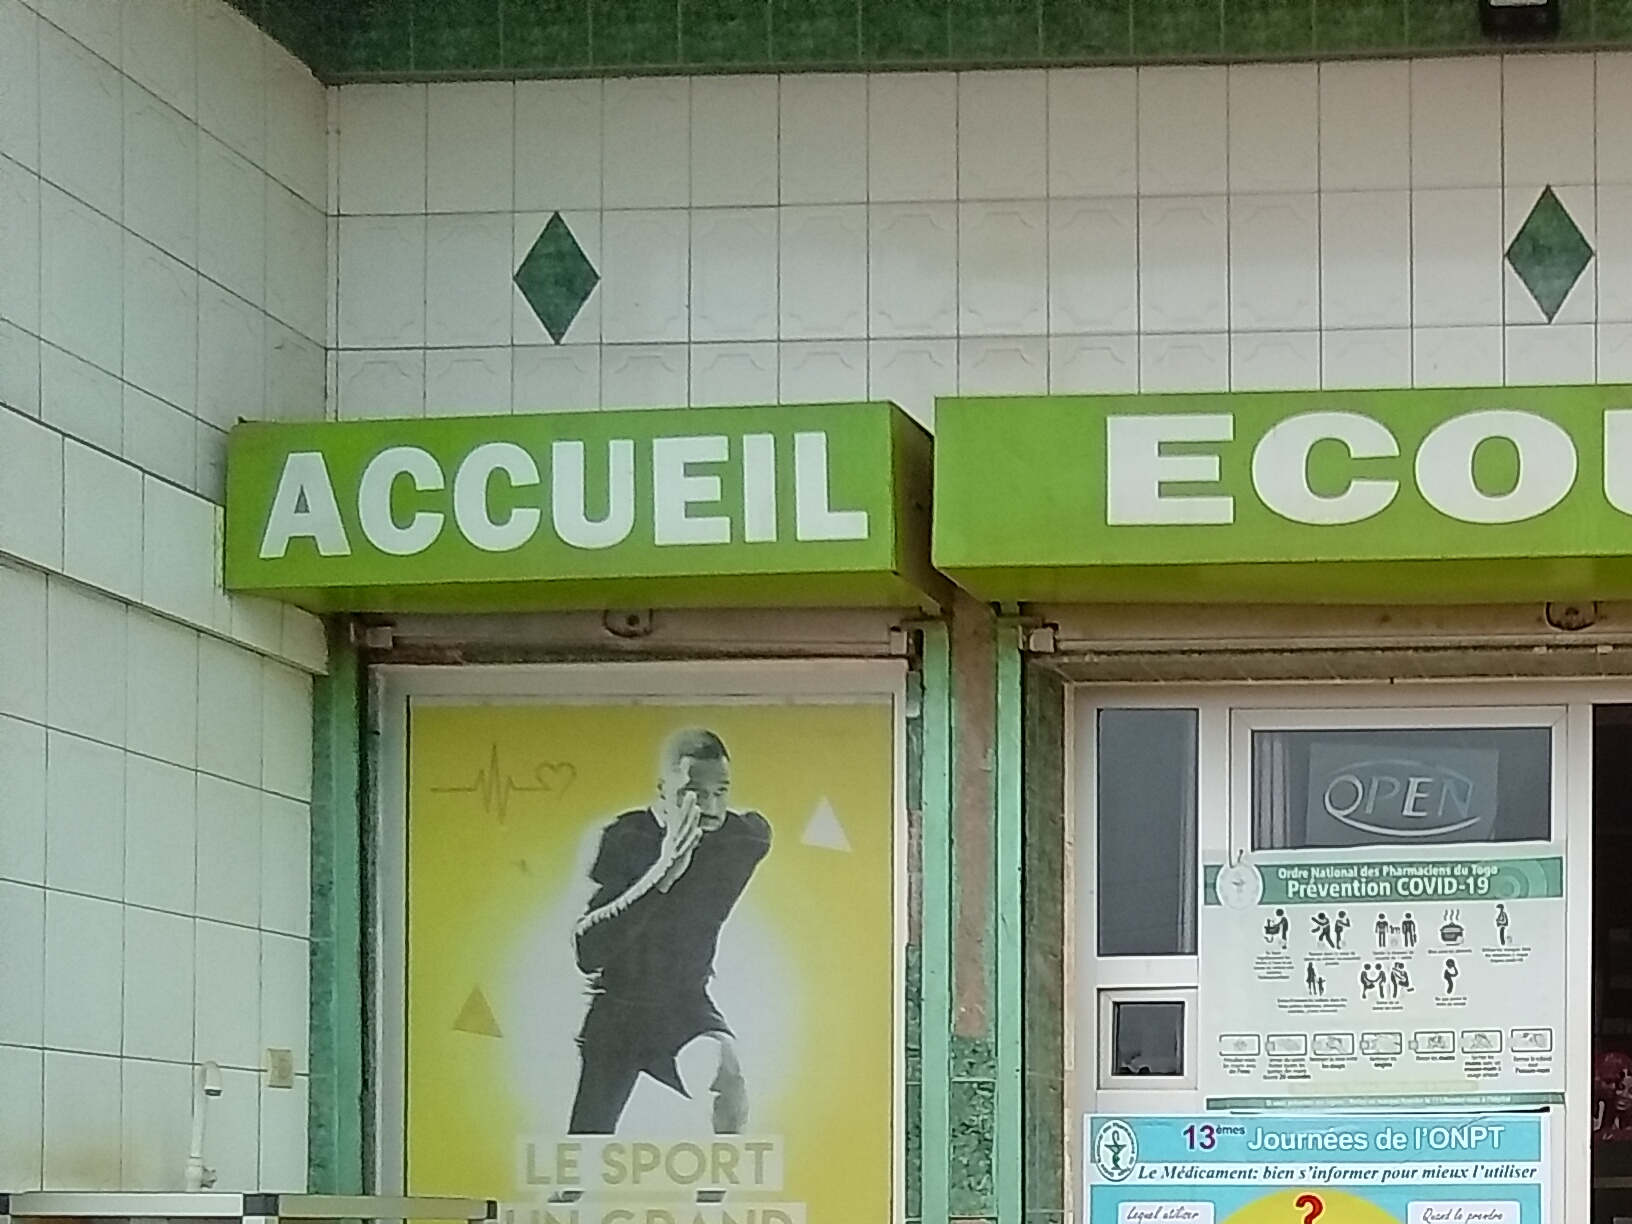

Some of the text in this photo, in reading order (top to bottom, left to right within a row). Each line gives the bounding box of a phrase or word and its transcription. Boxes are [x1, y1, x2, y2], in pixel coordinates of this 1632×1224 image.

[258, 430, 870, 559] ACCUEIL
[1324, 773, 1475, 821] OPEN
[1278, 862, 1498, 879] Ordre National des Pharmaciens du Togo
[1288, 876, 1489, 898] Prévention COVID-19
[1248, 1126, 1369, 1152] Journées
[1375, 1127, 1408, 1151] de
[1414, 1125, 1505, 1150] l'ONPT
[525, 1142, 774, 1185] LE SPORT
[1138, 1164, 1537, 1183] Le Médicament: bien s'informer pour mieux l'utiliser
